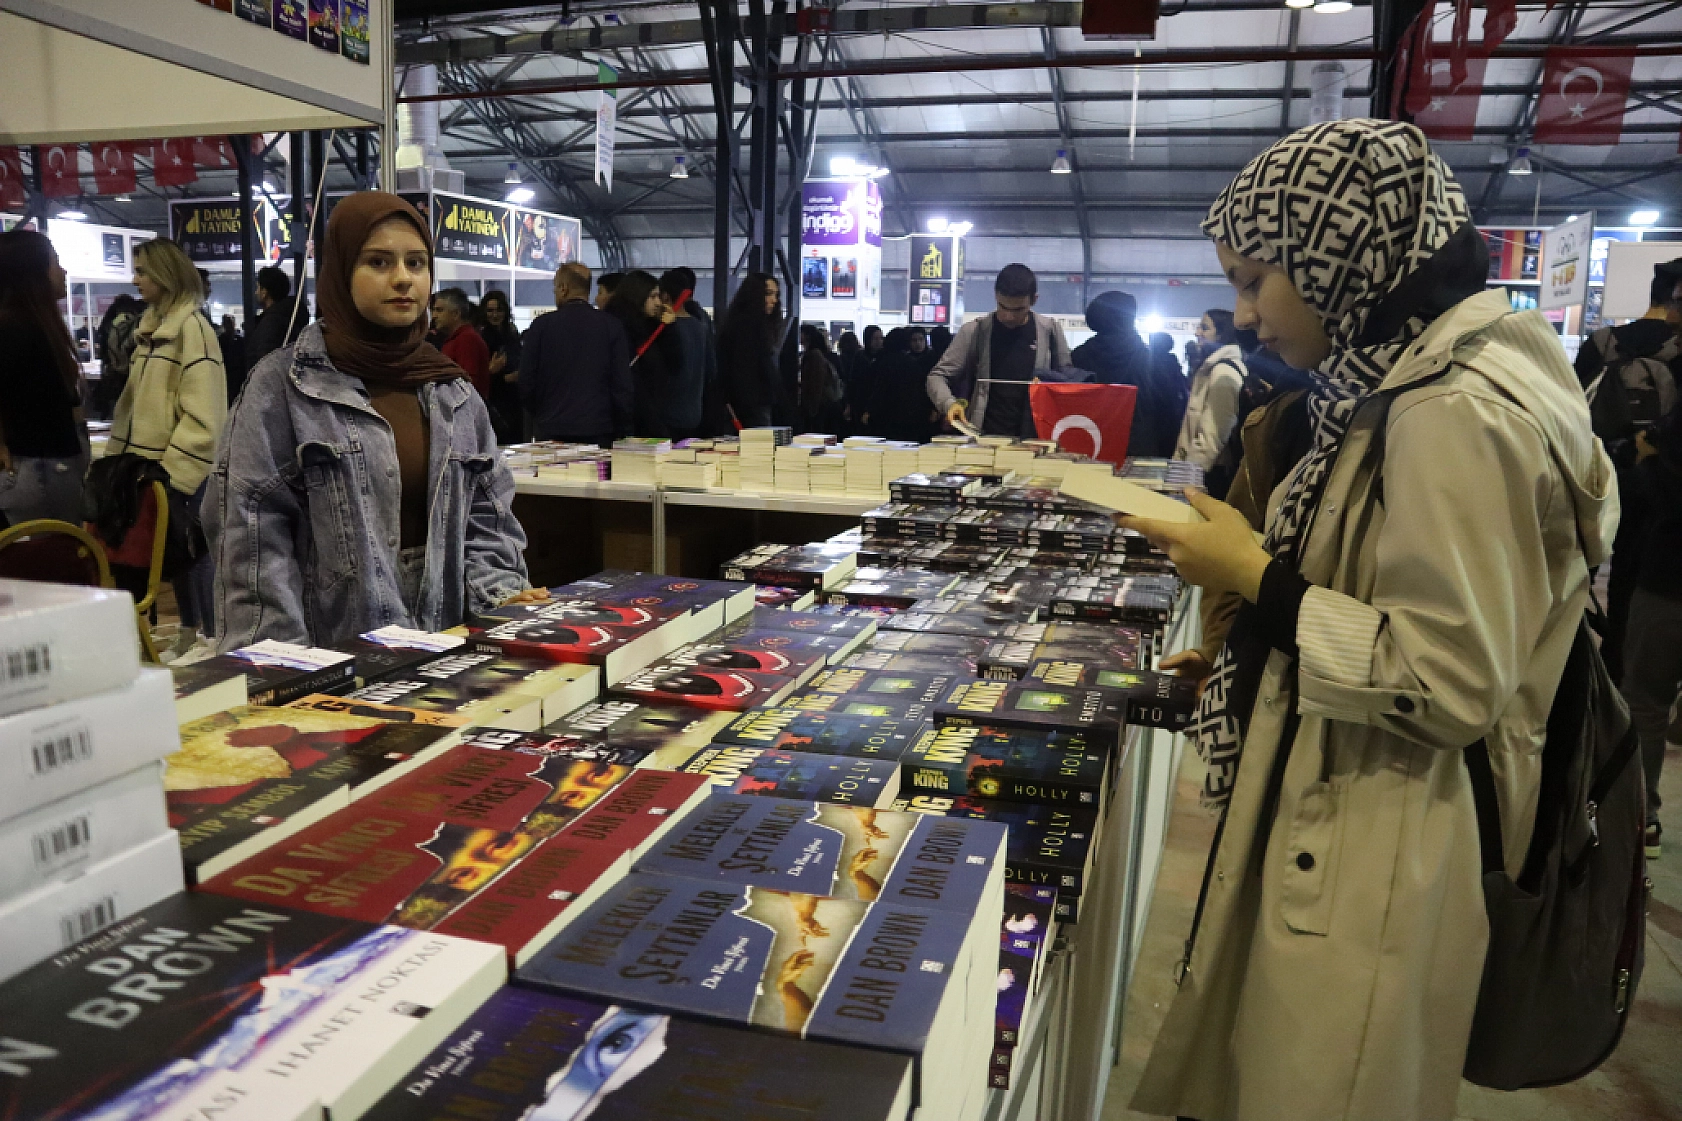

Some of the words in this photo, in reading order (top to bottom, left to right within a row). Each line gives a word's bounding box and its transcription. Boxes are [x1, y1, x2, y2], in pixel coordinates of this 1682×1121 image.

[461, 206, 495, 221] DAMLA
[957, 681, 1008, 713] KING
[737, 709, 802, 740] KING
[924, 727, 980, 764] KING
[698, 747, 766, 786] KING
[1059, 737, 1087, 776] HOLLY
[832, 760, 874, 801] HOLLY
[913, 772, 949, 790] KING
[1014, 784, 1069, 799] HOLLY
[572, 815, 627, 842] DAN
[604, 774, 673, 815] BROWN
[662, 801, 753, 862] MELEKLER
[718, 804, 808, 875] ŞEYTANLAR
[916, 821, 972, 865] BROWN
[1039, 811, 1072, 857] HOLLY
[232, 867, 323, 896] DA
[286, 818, 406, 863] VINCI
[1005, 867, 1049, 883] OLLY
[899, 865, 950, 900] DAN
[555, 886, 673, 968] MELEKLER
[619, 890, 740, 986] ŞEYTANLAR
[859, 911, 929, 973] BROWN
[67, 908, 292, 1030] BROWN
[86, 926, 190, 978] DAN
[359, 939, 449, 1012] NOKTASI
[835, 975, 900, 1024] DAN
[406, 1078, 435, 1096] Da
[424, 1056, 457, 1078] Vinci
